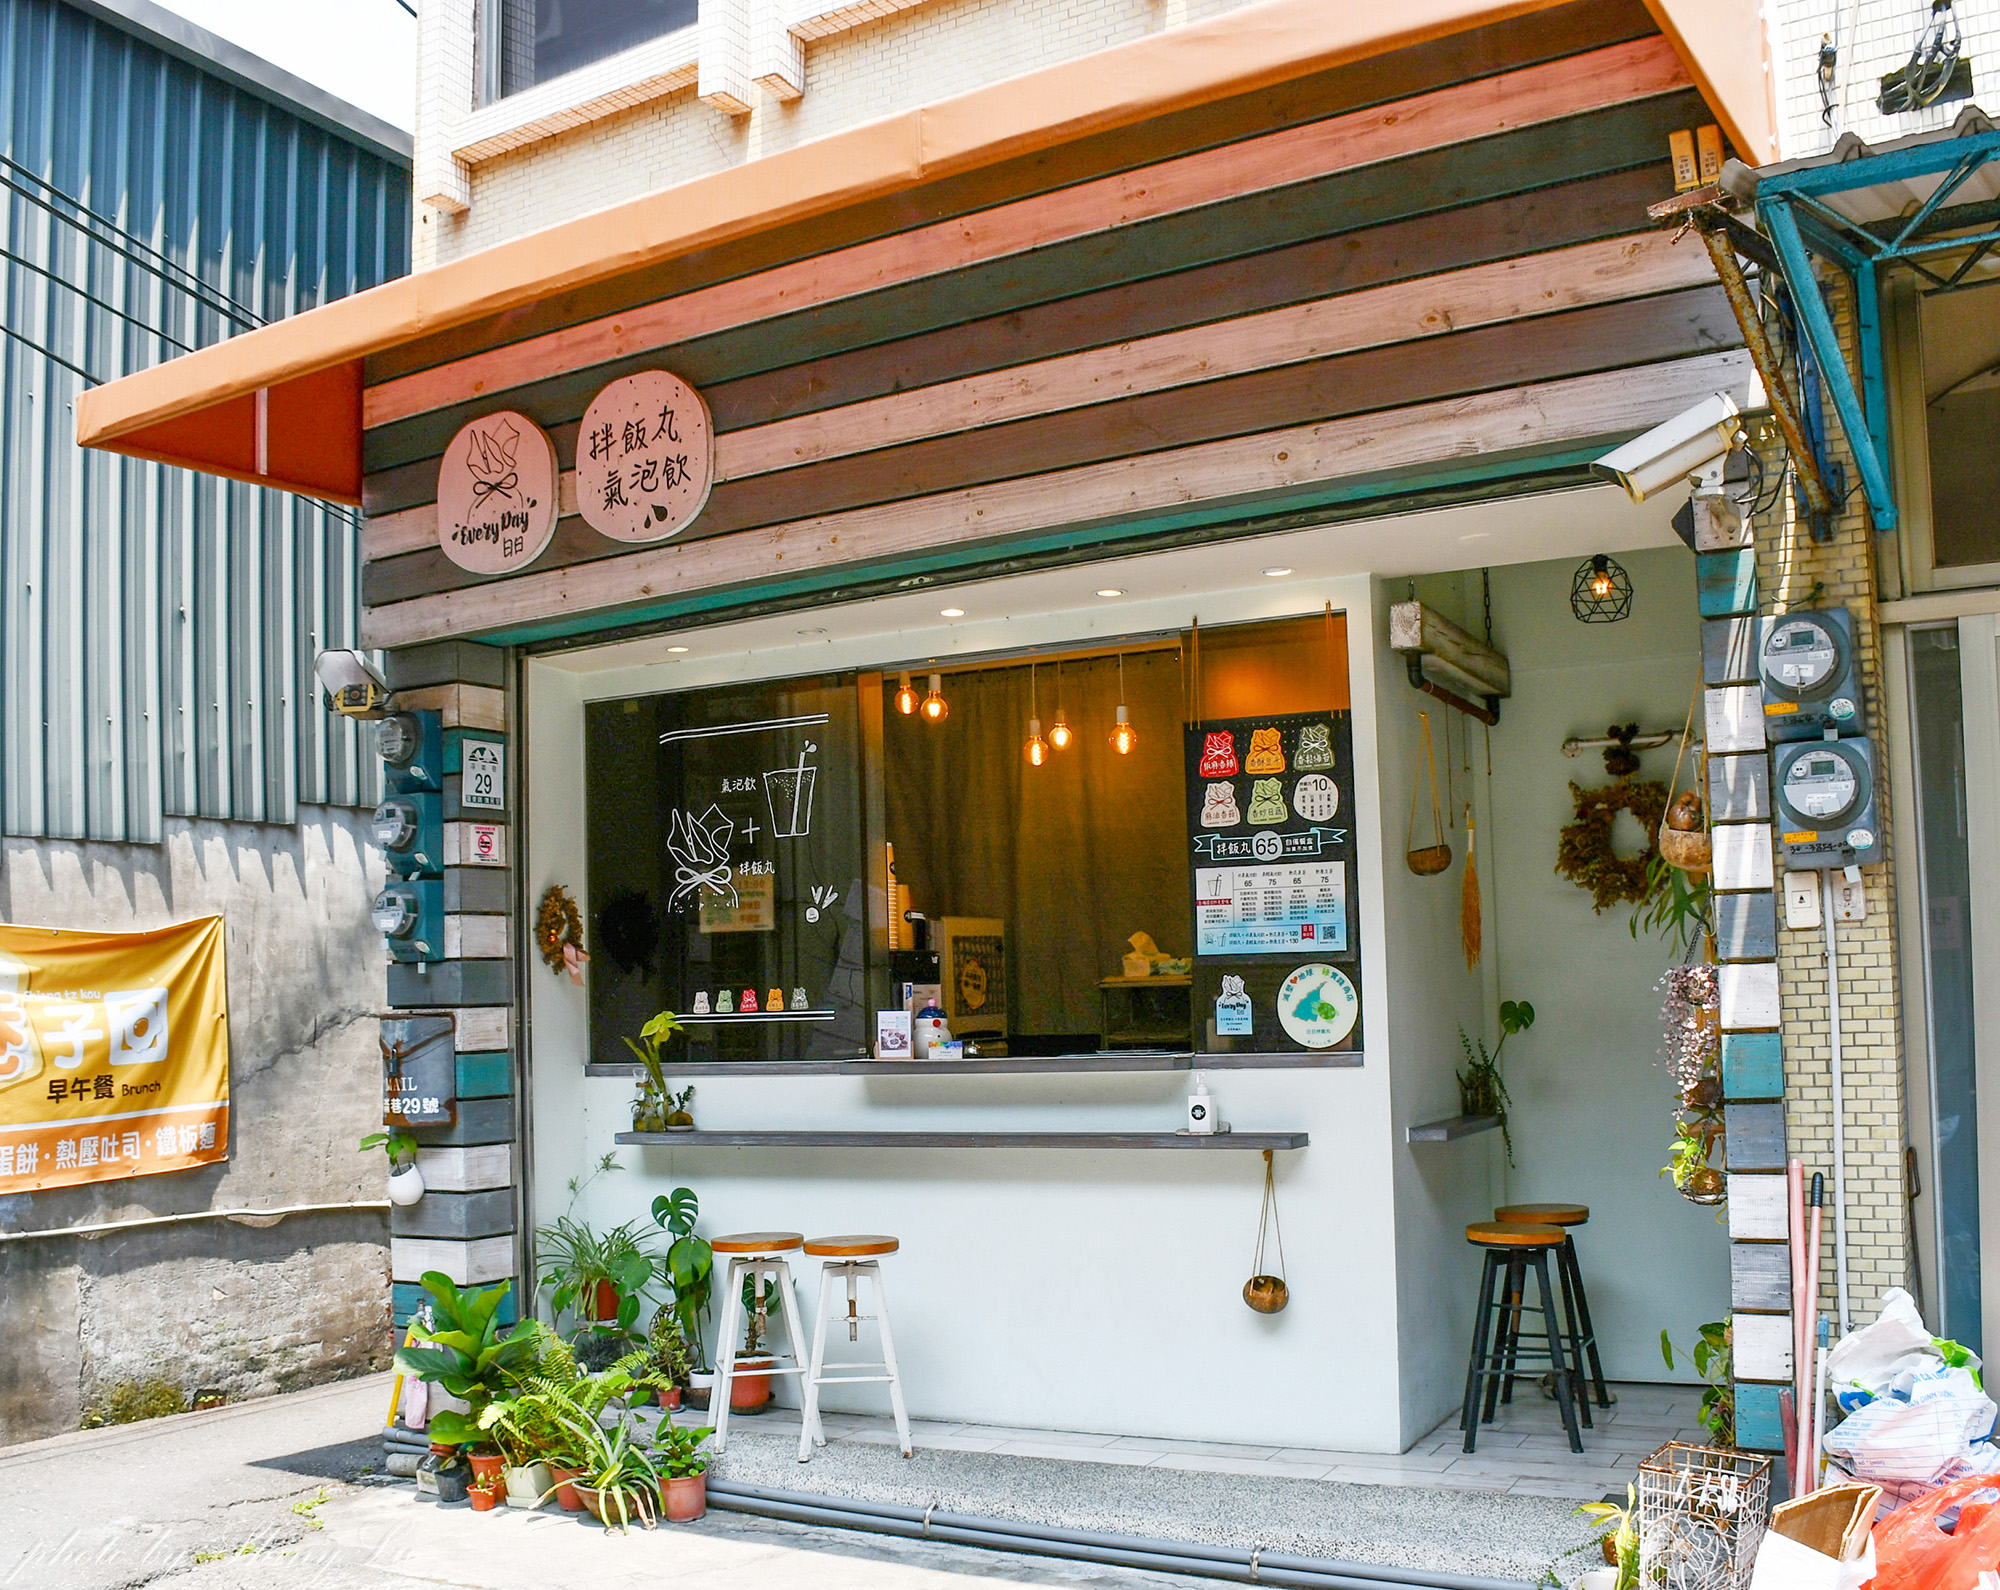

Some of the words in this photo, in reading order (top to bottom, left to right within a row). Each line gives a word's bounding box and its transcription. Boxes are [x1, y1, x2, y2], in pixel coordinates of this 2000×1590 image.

[588, 405, 678, 461] 拌飯丸
[602, 454, 692, 512] 氣泡飲
[460, 520, 499, 546] Every
[500, 510, 530, 533] Day
[502, 537, 524, 558] 日日
[474, 772, 493, 795] 29
[720, 776, 757, 794] 氣泡飲
[1312, 777, 1328, 792] 10
[1216, 842, 1251, 856] 拌飯丸
[1255, 837, 1278, 856] 65
[738, 861, 776, 877] 拌飯丸
[1244, 879, 1253, 887] 65
[1268, 878, 1277, 886] 75
[1292, 877, 1302, 885] 65
[1320, 875, 1330, 883] 75
[80, 988, 101, 1000] kou
[47, 1074, 115, 1104] 早午餐
[121, 1081, 161, 1097] Brunch
[55, 1131, 140, 1171] 熱壓吐司
[155, 1122, 216, 1157] 鐵板麵
